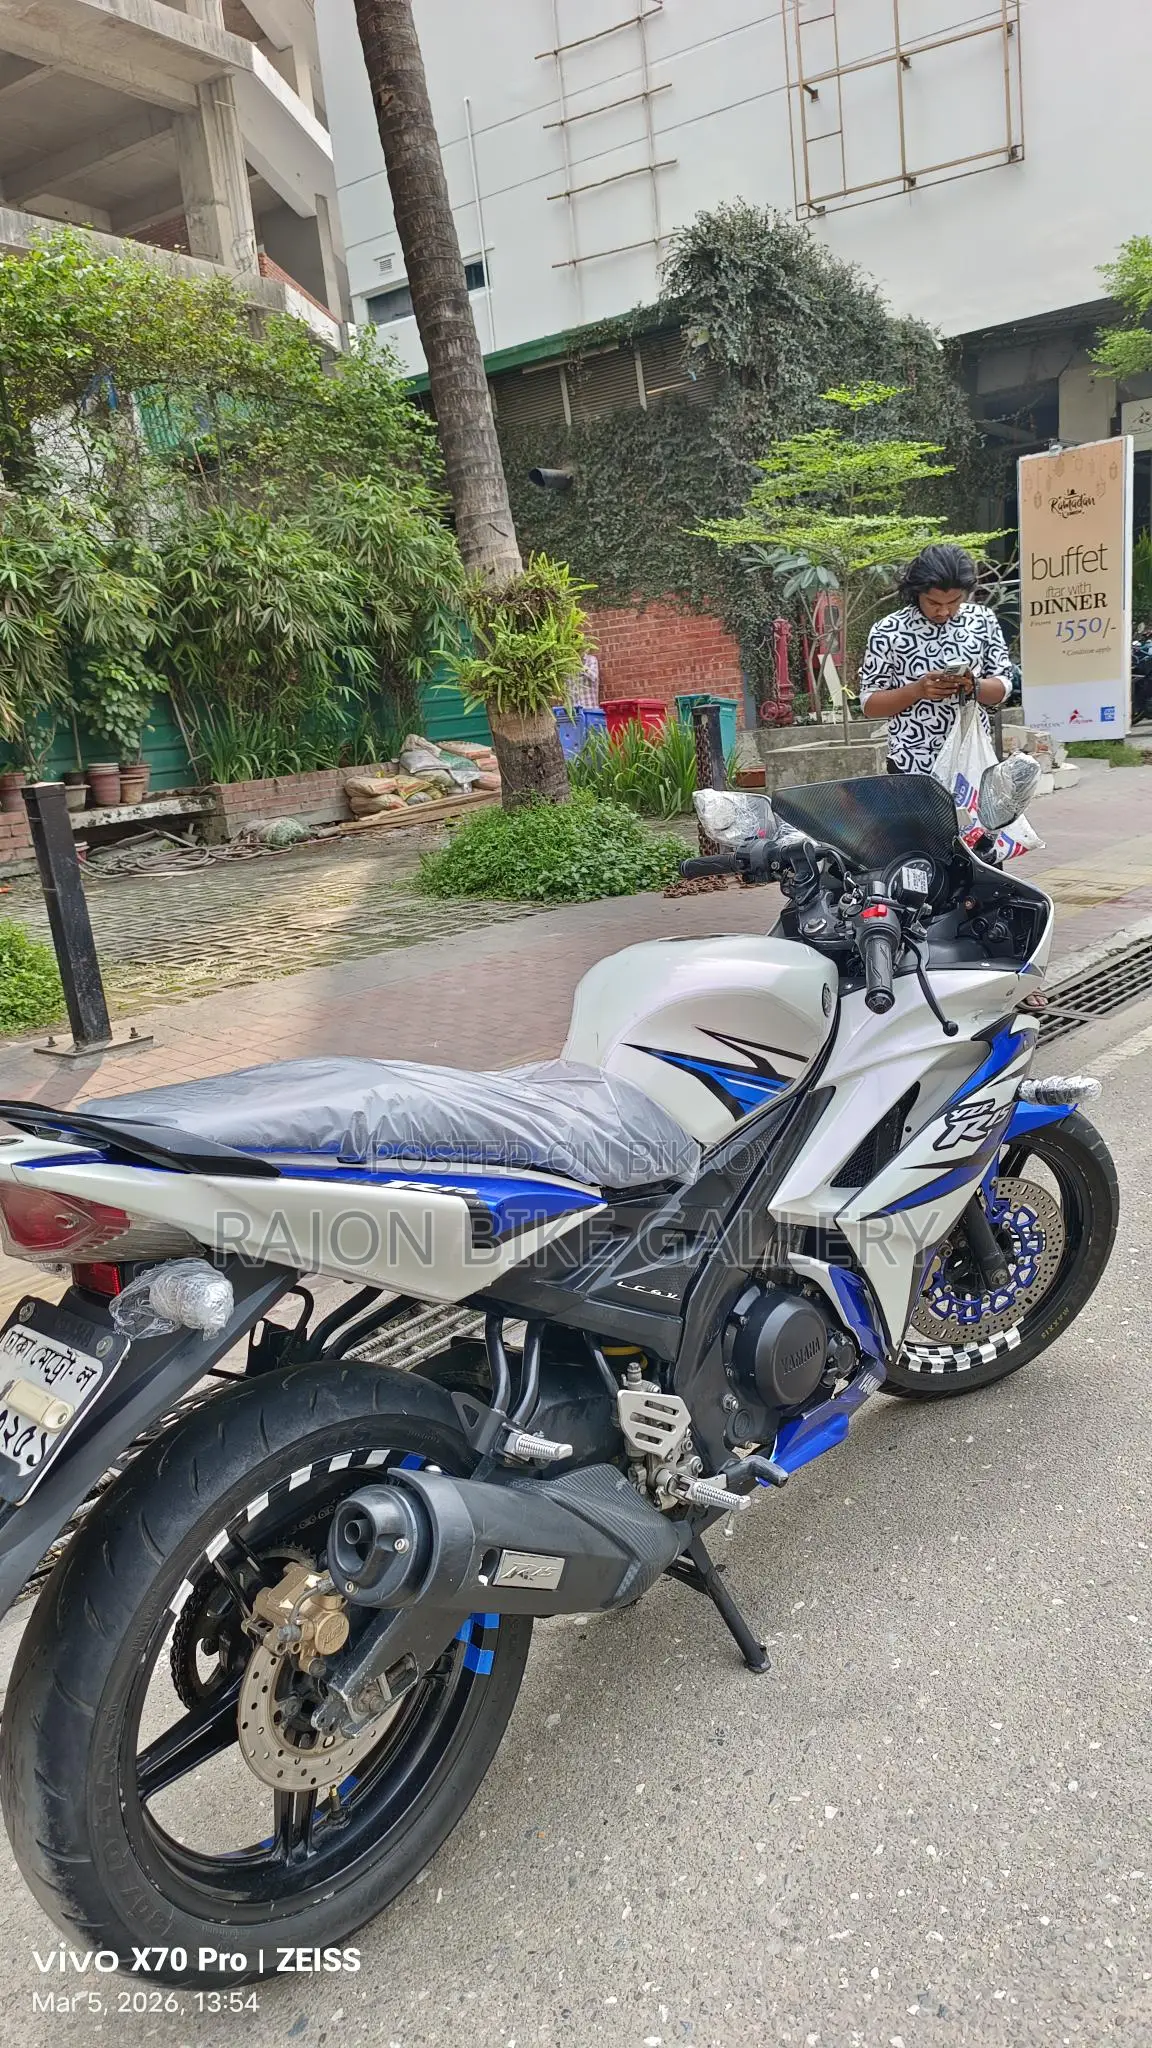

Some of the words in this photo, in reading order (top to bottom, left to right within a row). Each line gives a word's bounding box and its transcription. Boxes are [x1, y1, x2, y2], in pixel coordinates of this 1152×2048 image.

[1031, 543, 1109, 581] buffet
[1067, 582, 1092, 597] with
[1030, 592, 1108, 617] DINNER
[1055, 617, 1117, 643] 1550/-
[950, 1102, 995, 1121] YZF
[936, 1104, 1013, 1148] R15
[781, 1336, 821, 1376] YAMAHA
